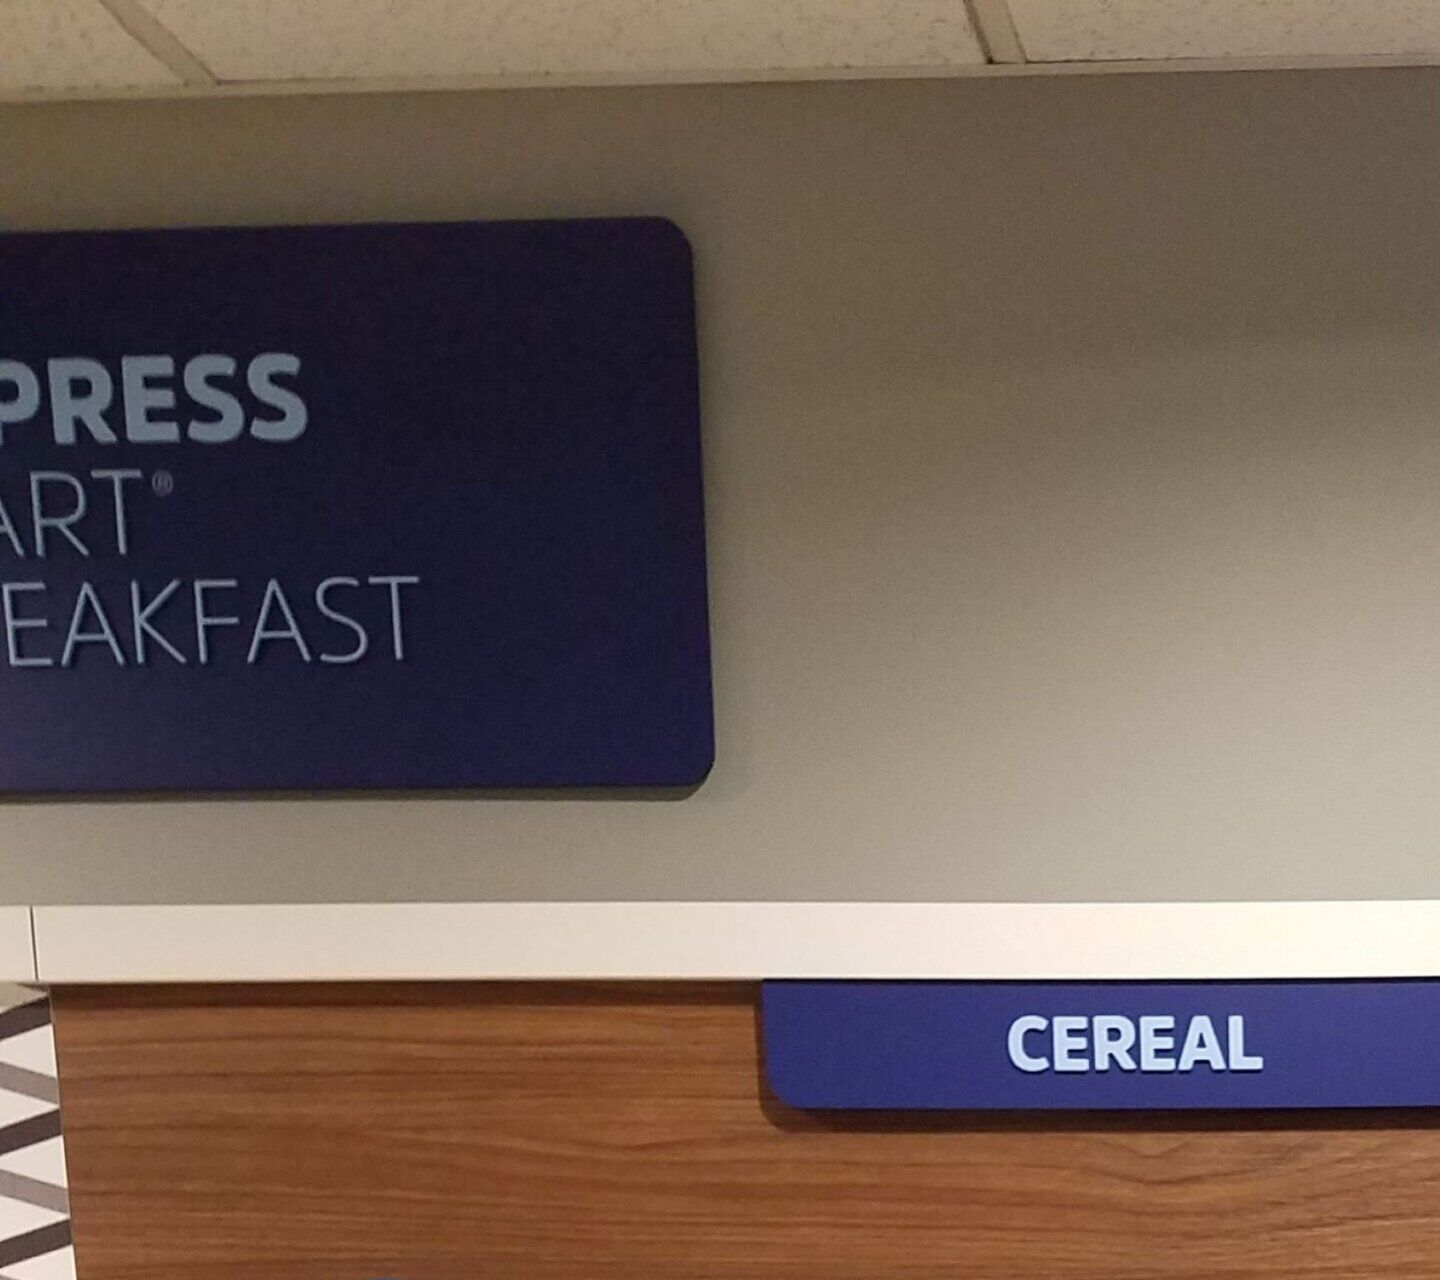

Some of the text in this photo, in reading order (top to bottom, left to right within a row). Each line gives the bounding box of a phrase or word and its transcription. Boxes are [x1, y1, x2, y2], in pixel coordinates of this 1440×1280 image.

[0, 352, 309, 445] PRESS
[2, 576, 420, 667] EAKFAST
[1007, 1014, 1264, 1073] CEREAL
